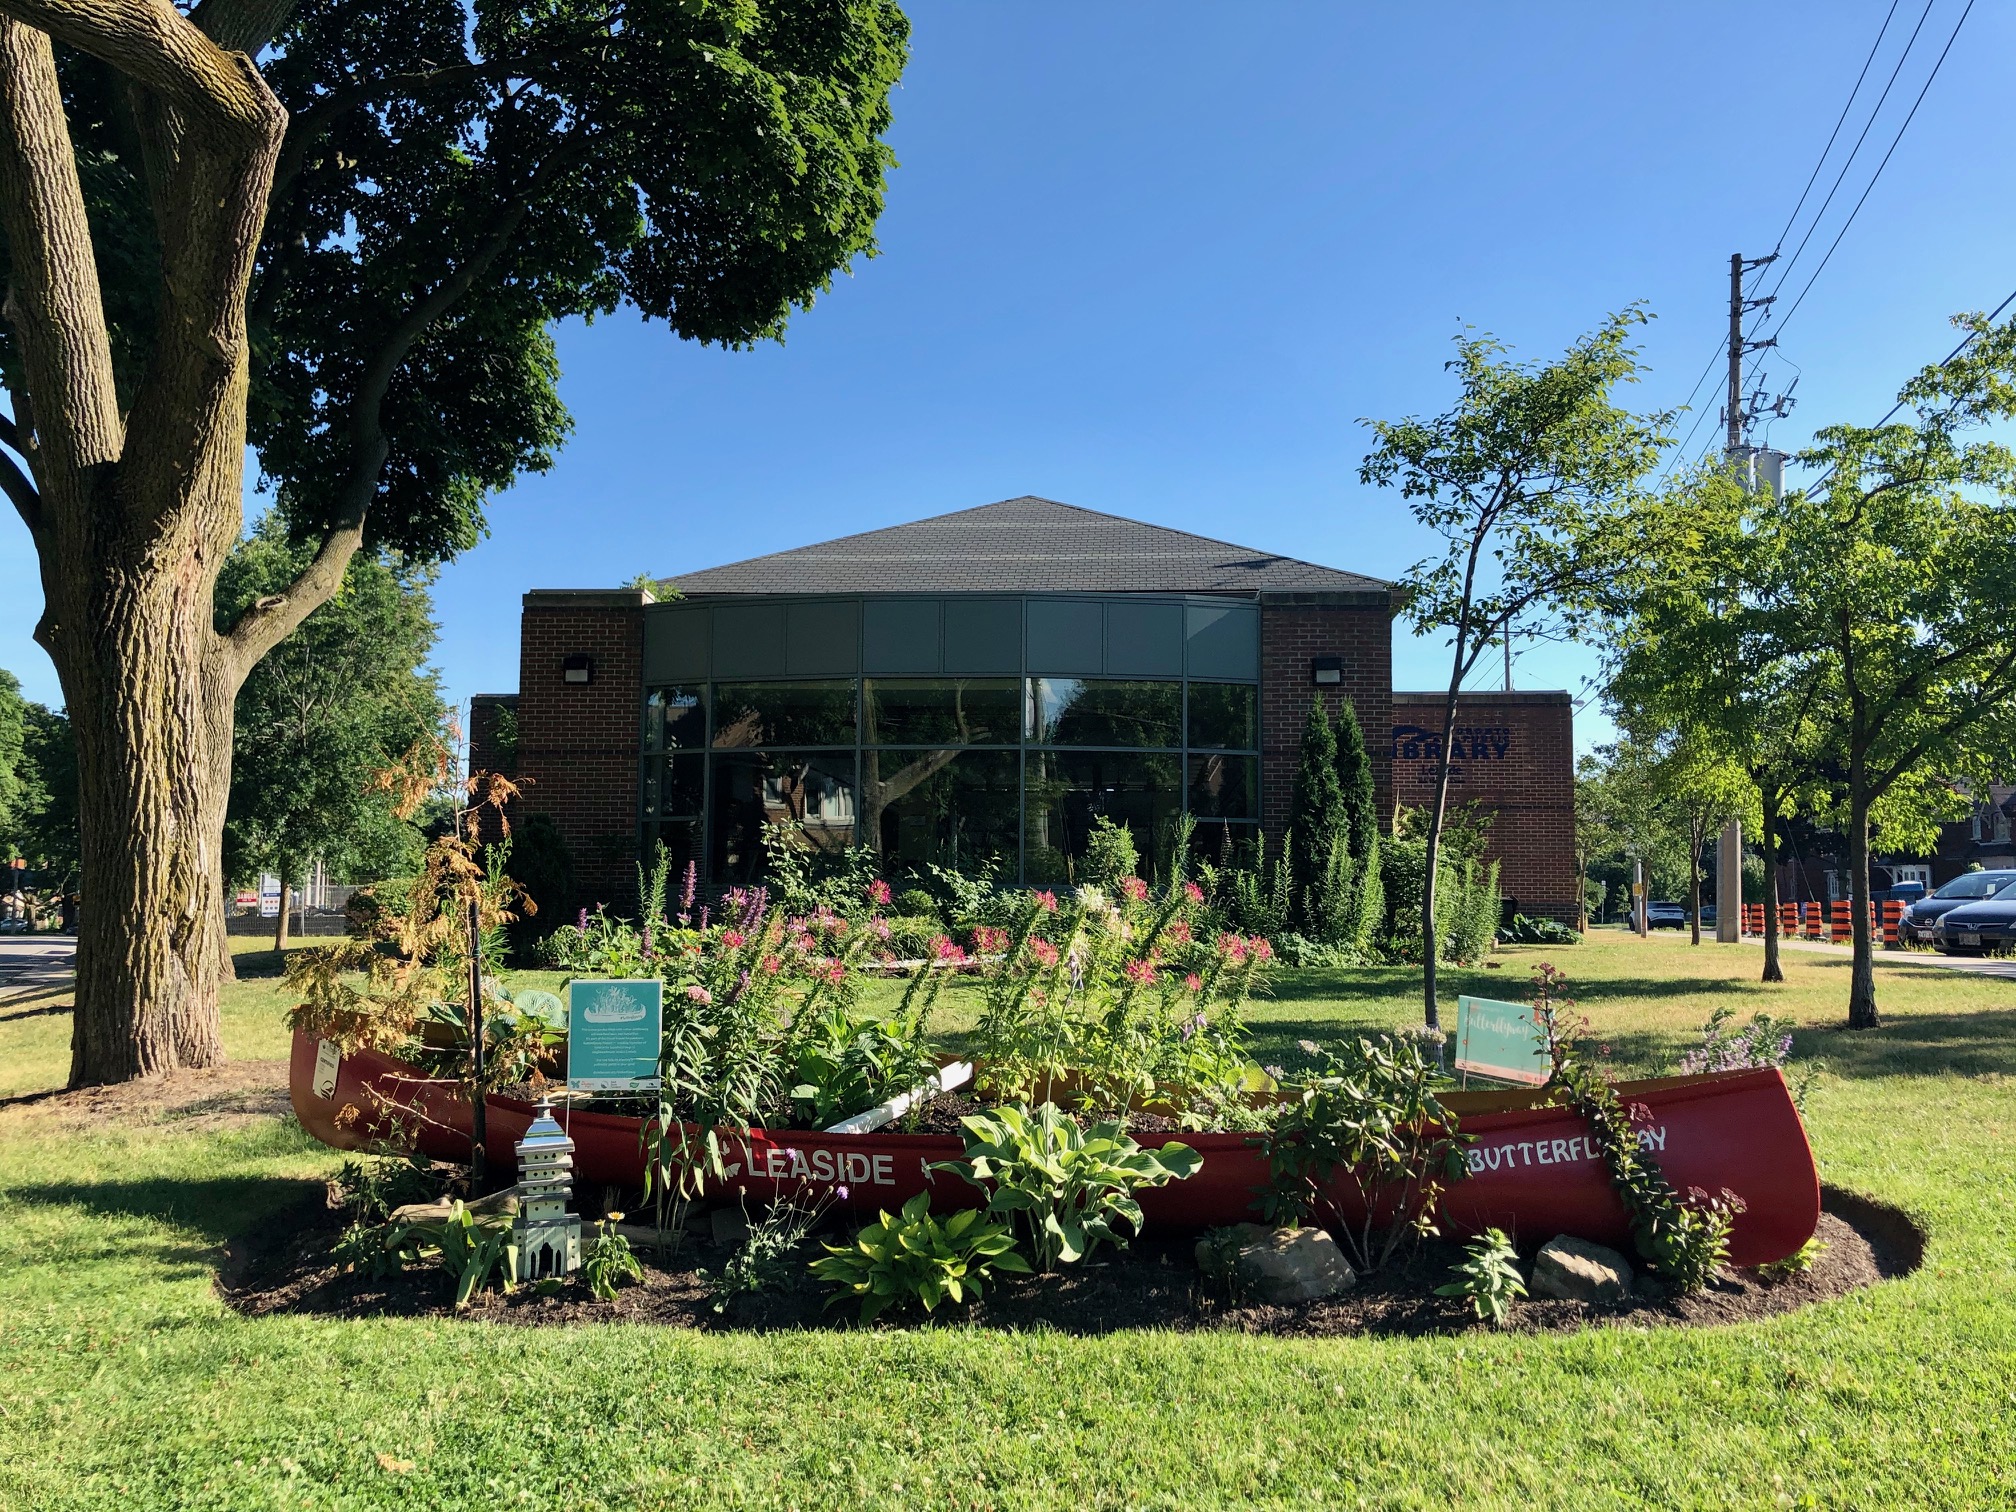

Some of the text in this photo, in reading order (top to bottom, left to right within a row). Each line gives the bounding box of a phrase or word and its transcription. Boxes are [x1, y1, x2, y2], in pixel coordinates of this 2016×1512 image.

[1391, 742, 1510, 759] IBRARY
[747, 1148, 896, 1185] LEASIDE
[1470, 1126, 1666, 1172] BUTTERFLAY
